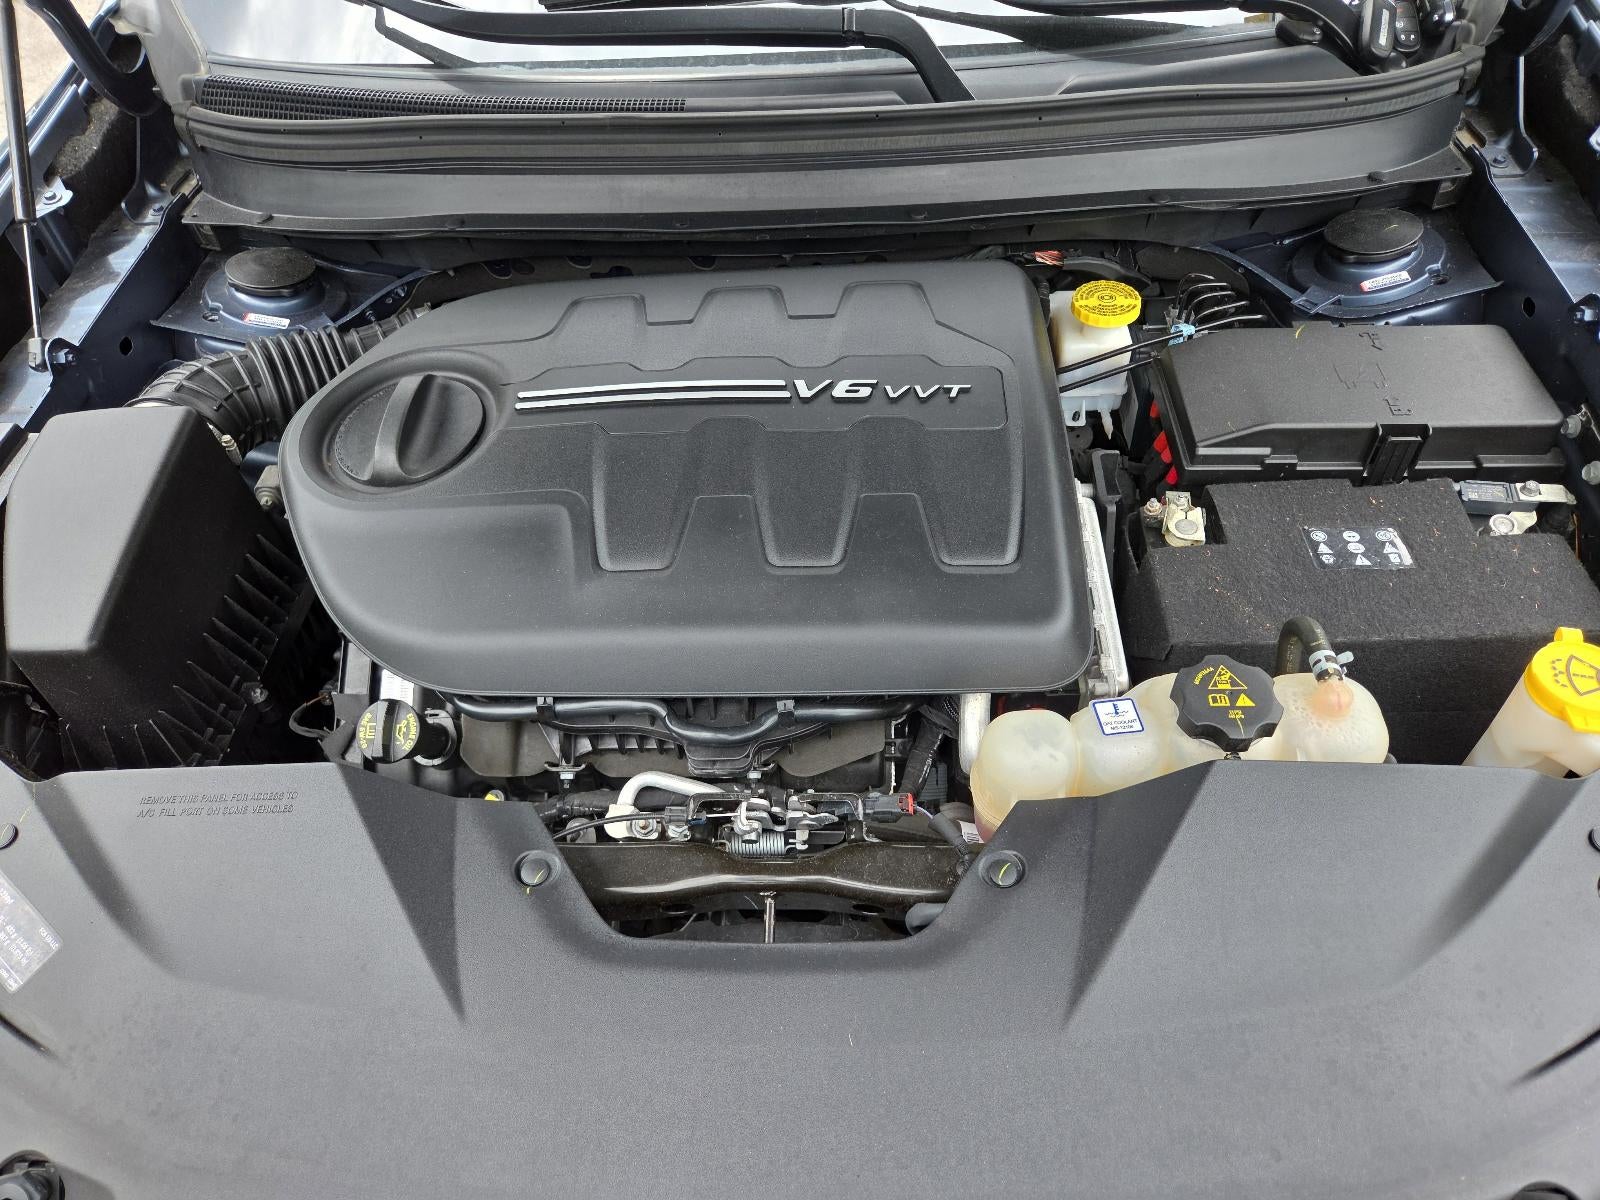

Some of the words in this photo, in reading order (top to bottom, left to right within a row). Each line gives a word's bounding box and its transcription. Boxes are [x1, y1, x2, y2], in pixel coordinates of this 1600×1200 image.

[793, 378, 879, 399] V6
[884, 384, 972, 399] VVT
[407, 713, 416, 739] ENGINE
[402, 739, 414, 751] OIL
[140, 795, 176, 806] REMOVE
[176, 794, 199, 805] THIS
[201, 793, 229, 803] PANEL
[230, 793, 249, 802] FOR
[250, 791, 285, 801] ACCESS
[287, 790, 299, 800] TO
[137, 808, 155, 818] A/C
[159, 808, 177, 817] FILL
[180, 807, 204, 817] PORT
[206, 806, 221, 816] ON
[222, 805, 249, 816] SOME
[252, 804, 294, 814] VEHICLES
